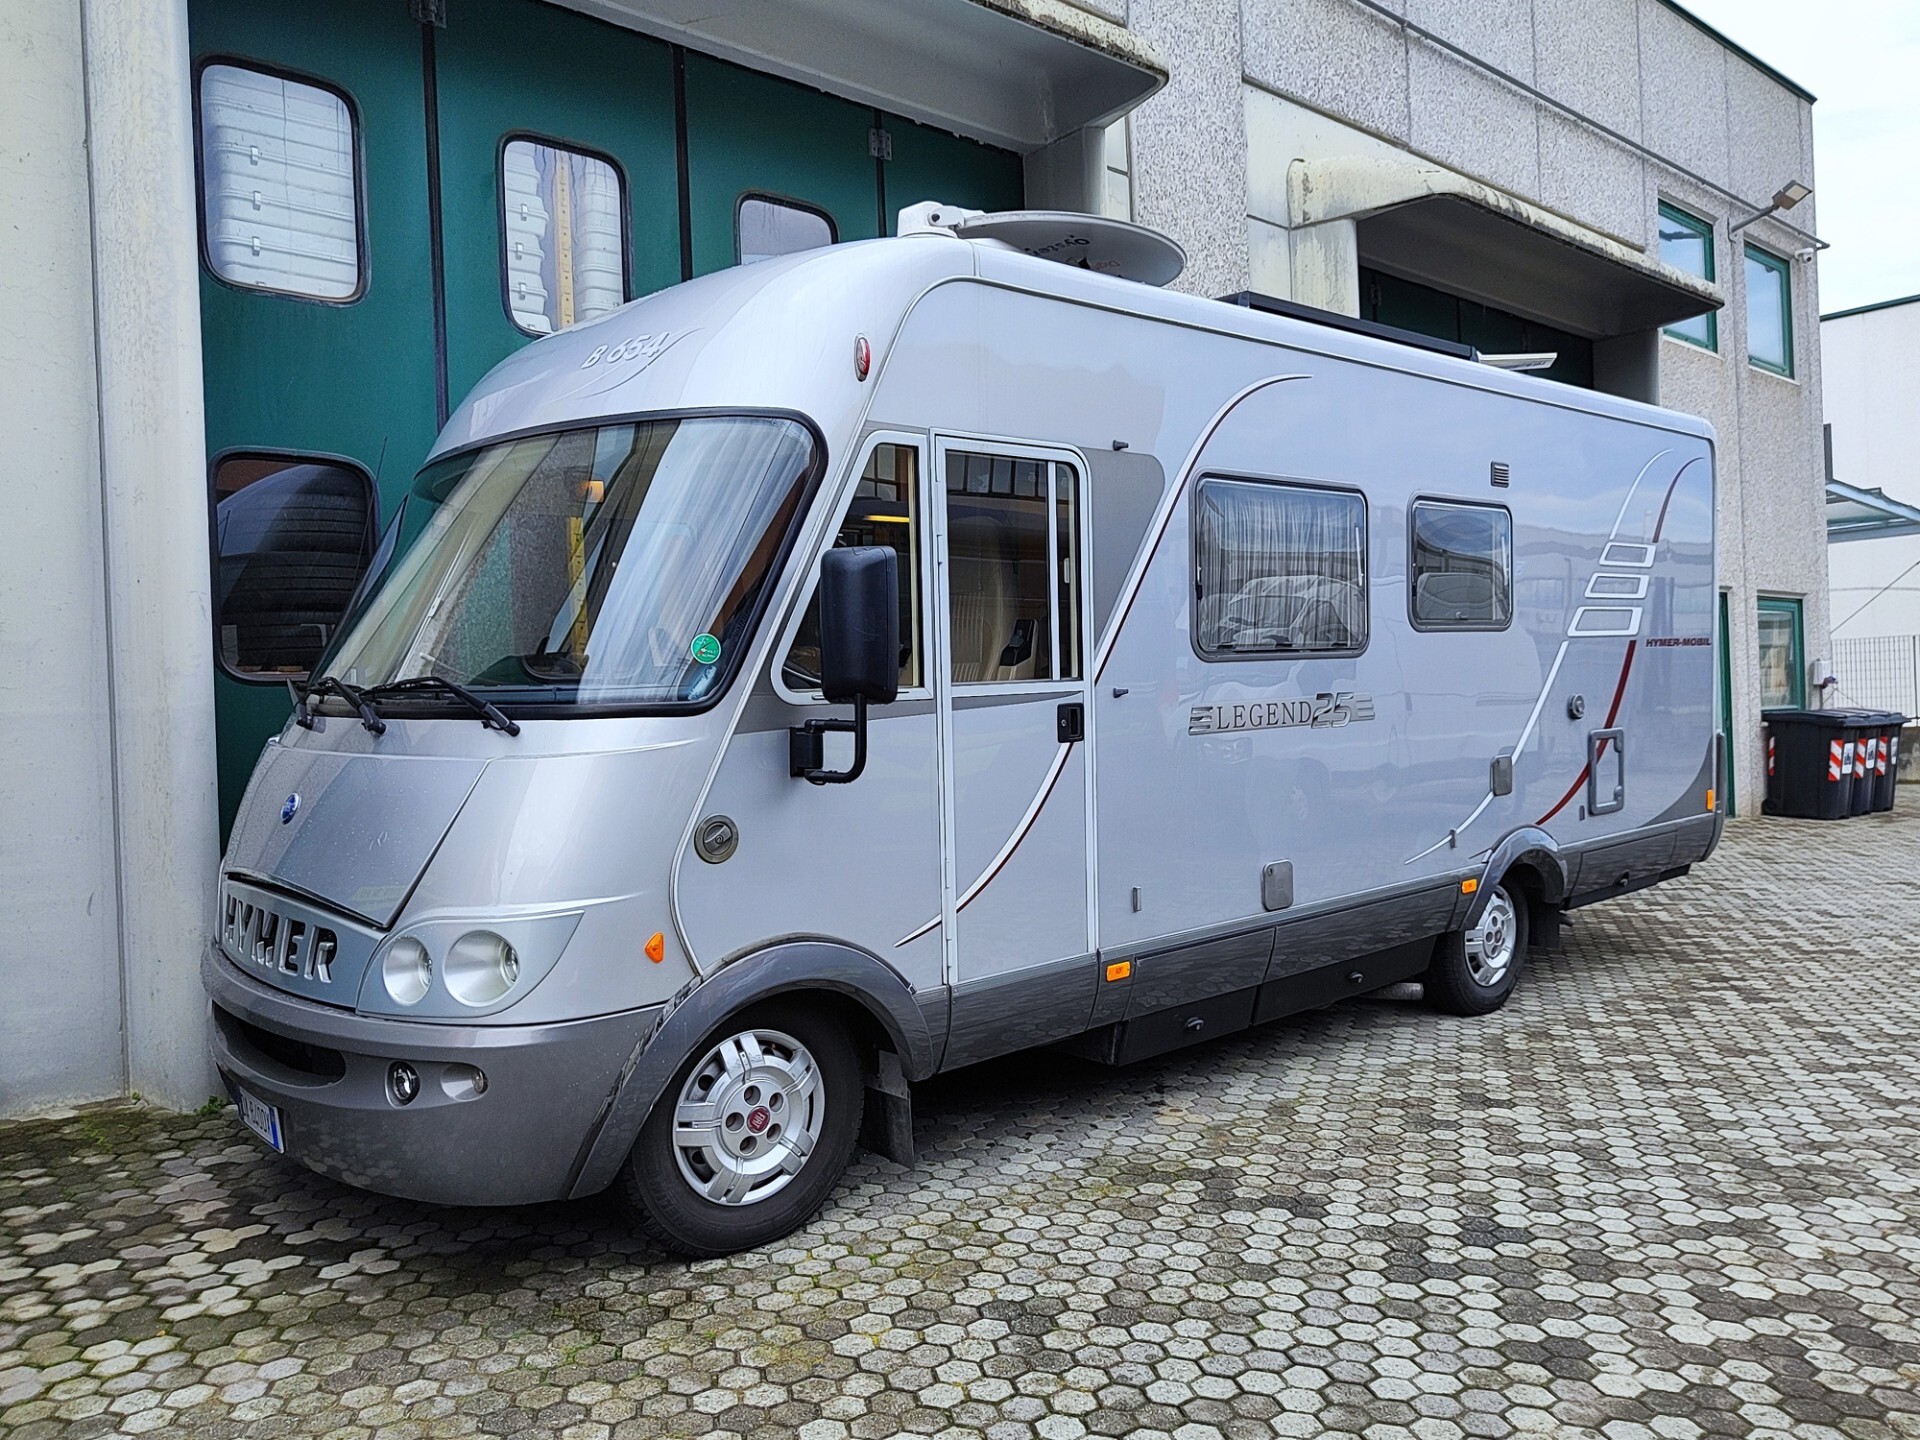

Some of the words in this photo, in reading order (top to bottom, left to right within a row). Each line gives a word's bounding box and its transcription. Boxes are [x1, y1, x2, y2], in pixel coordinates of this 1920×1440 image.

[580, 344, 609, 370] B
[606, 331, 670, 363] 654
[1645, 637, 1712, 648] HYMER-MOBIL
[1216, 701, 1312, 730] LEGEND
[1310, 691, 1354, 729] 25
[225, 893, 338, 984] HYMER
[751, 1111, 766, 1129] FIAT
